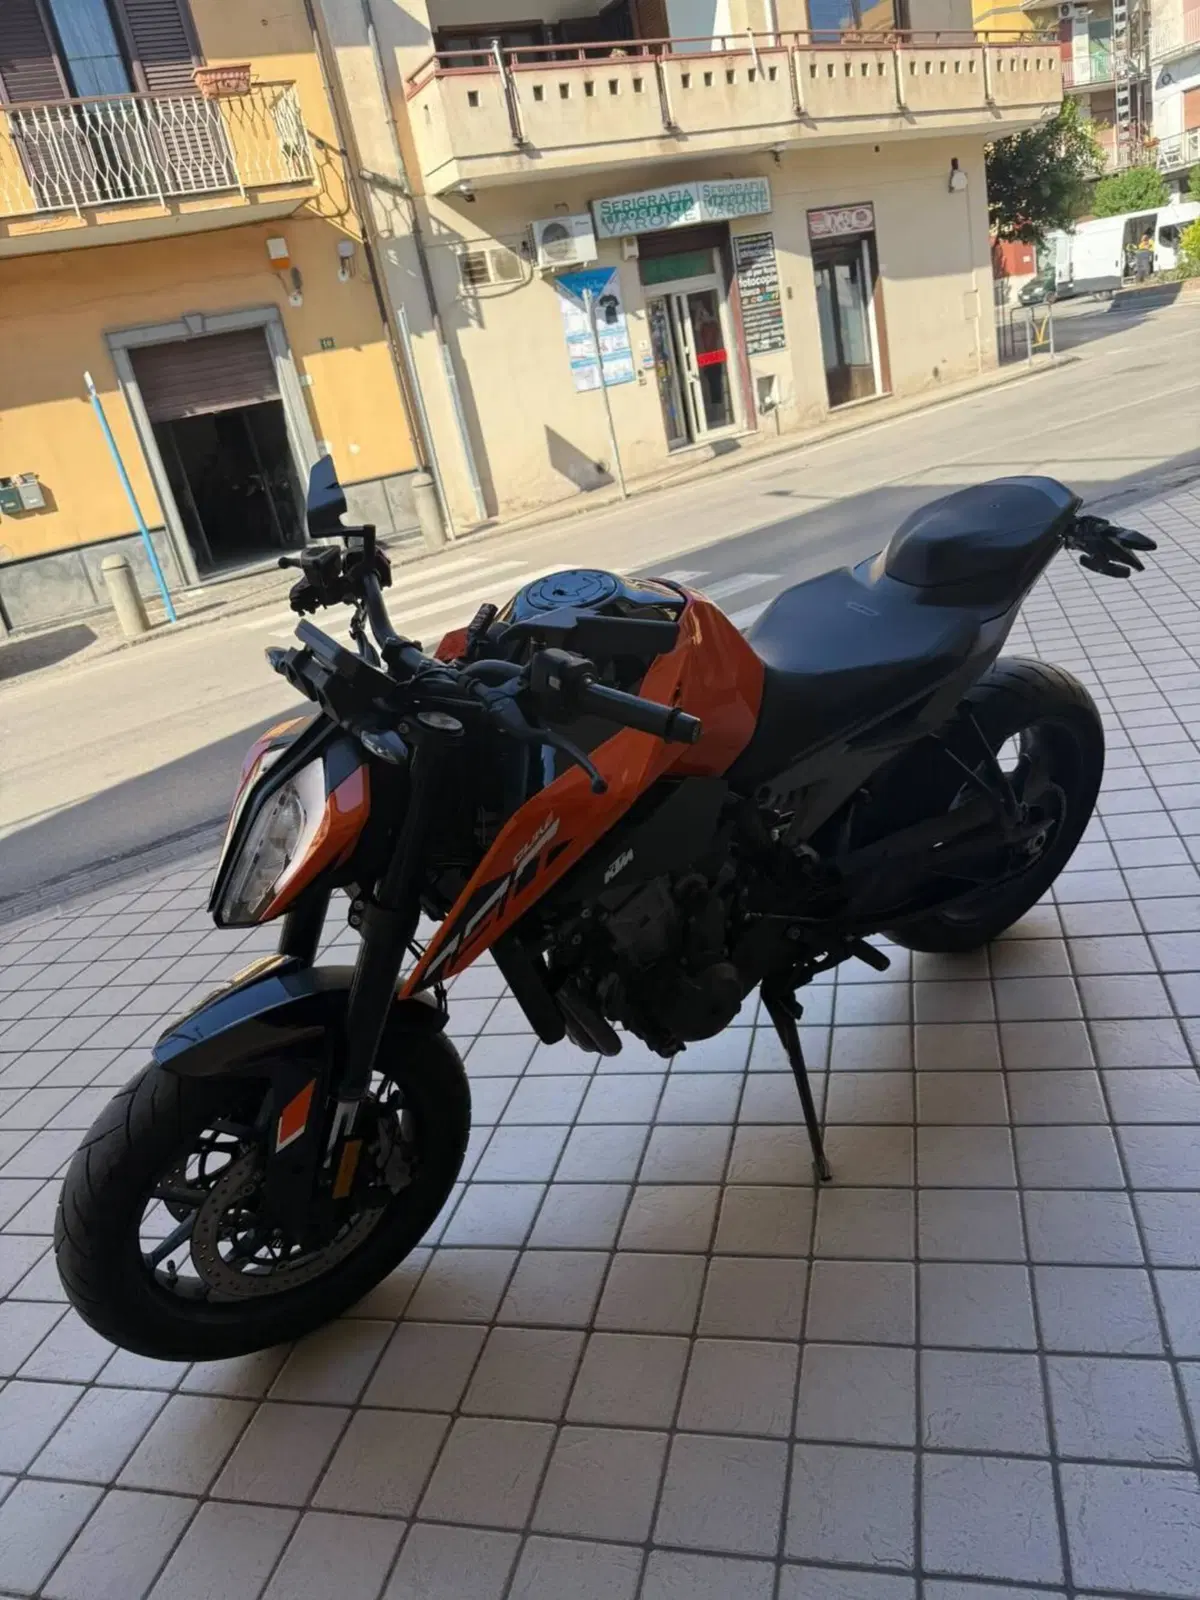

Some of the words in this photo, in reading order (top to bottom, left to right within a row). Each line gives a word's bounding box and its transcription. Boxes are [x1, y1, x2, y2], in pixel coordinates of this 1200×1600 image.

[601, 189, 692, 214] SERIGRAFIA
[703, 181, 766, 198] SERIGRAFIA
[603, 200, 694, 224] TIPOGRAFIA
[603, 209, 697, 234] VARONE
[705, 202, 769, 218] VARONE
[604, 847, 635, 885] KTM
